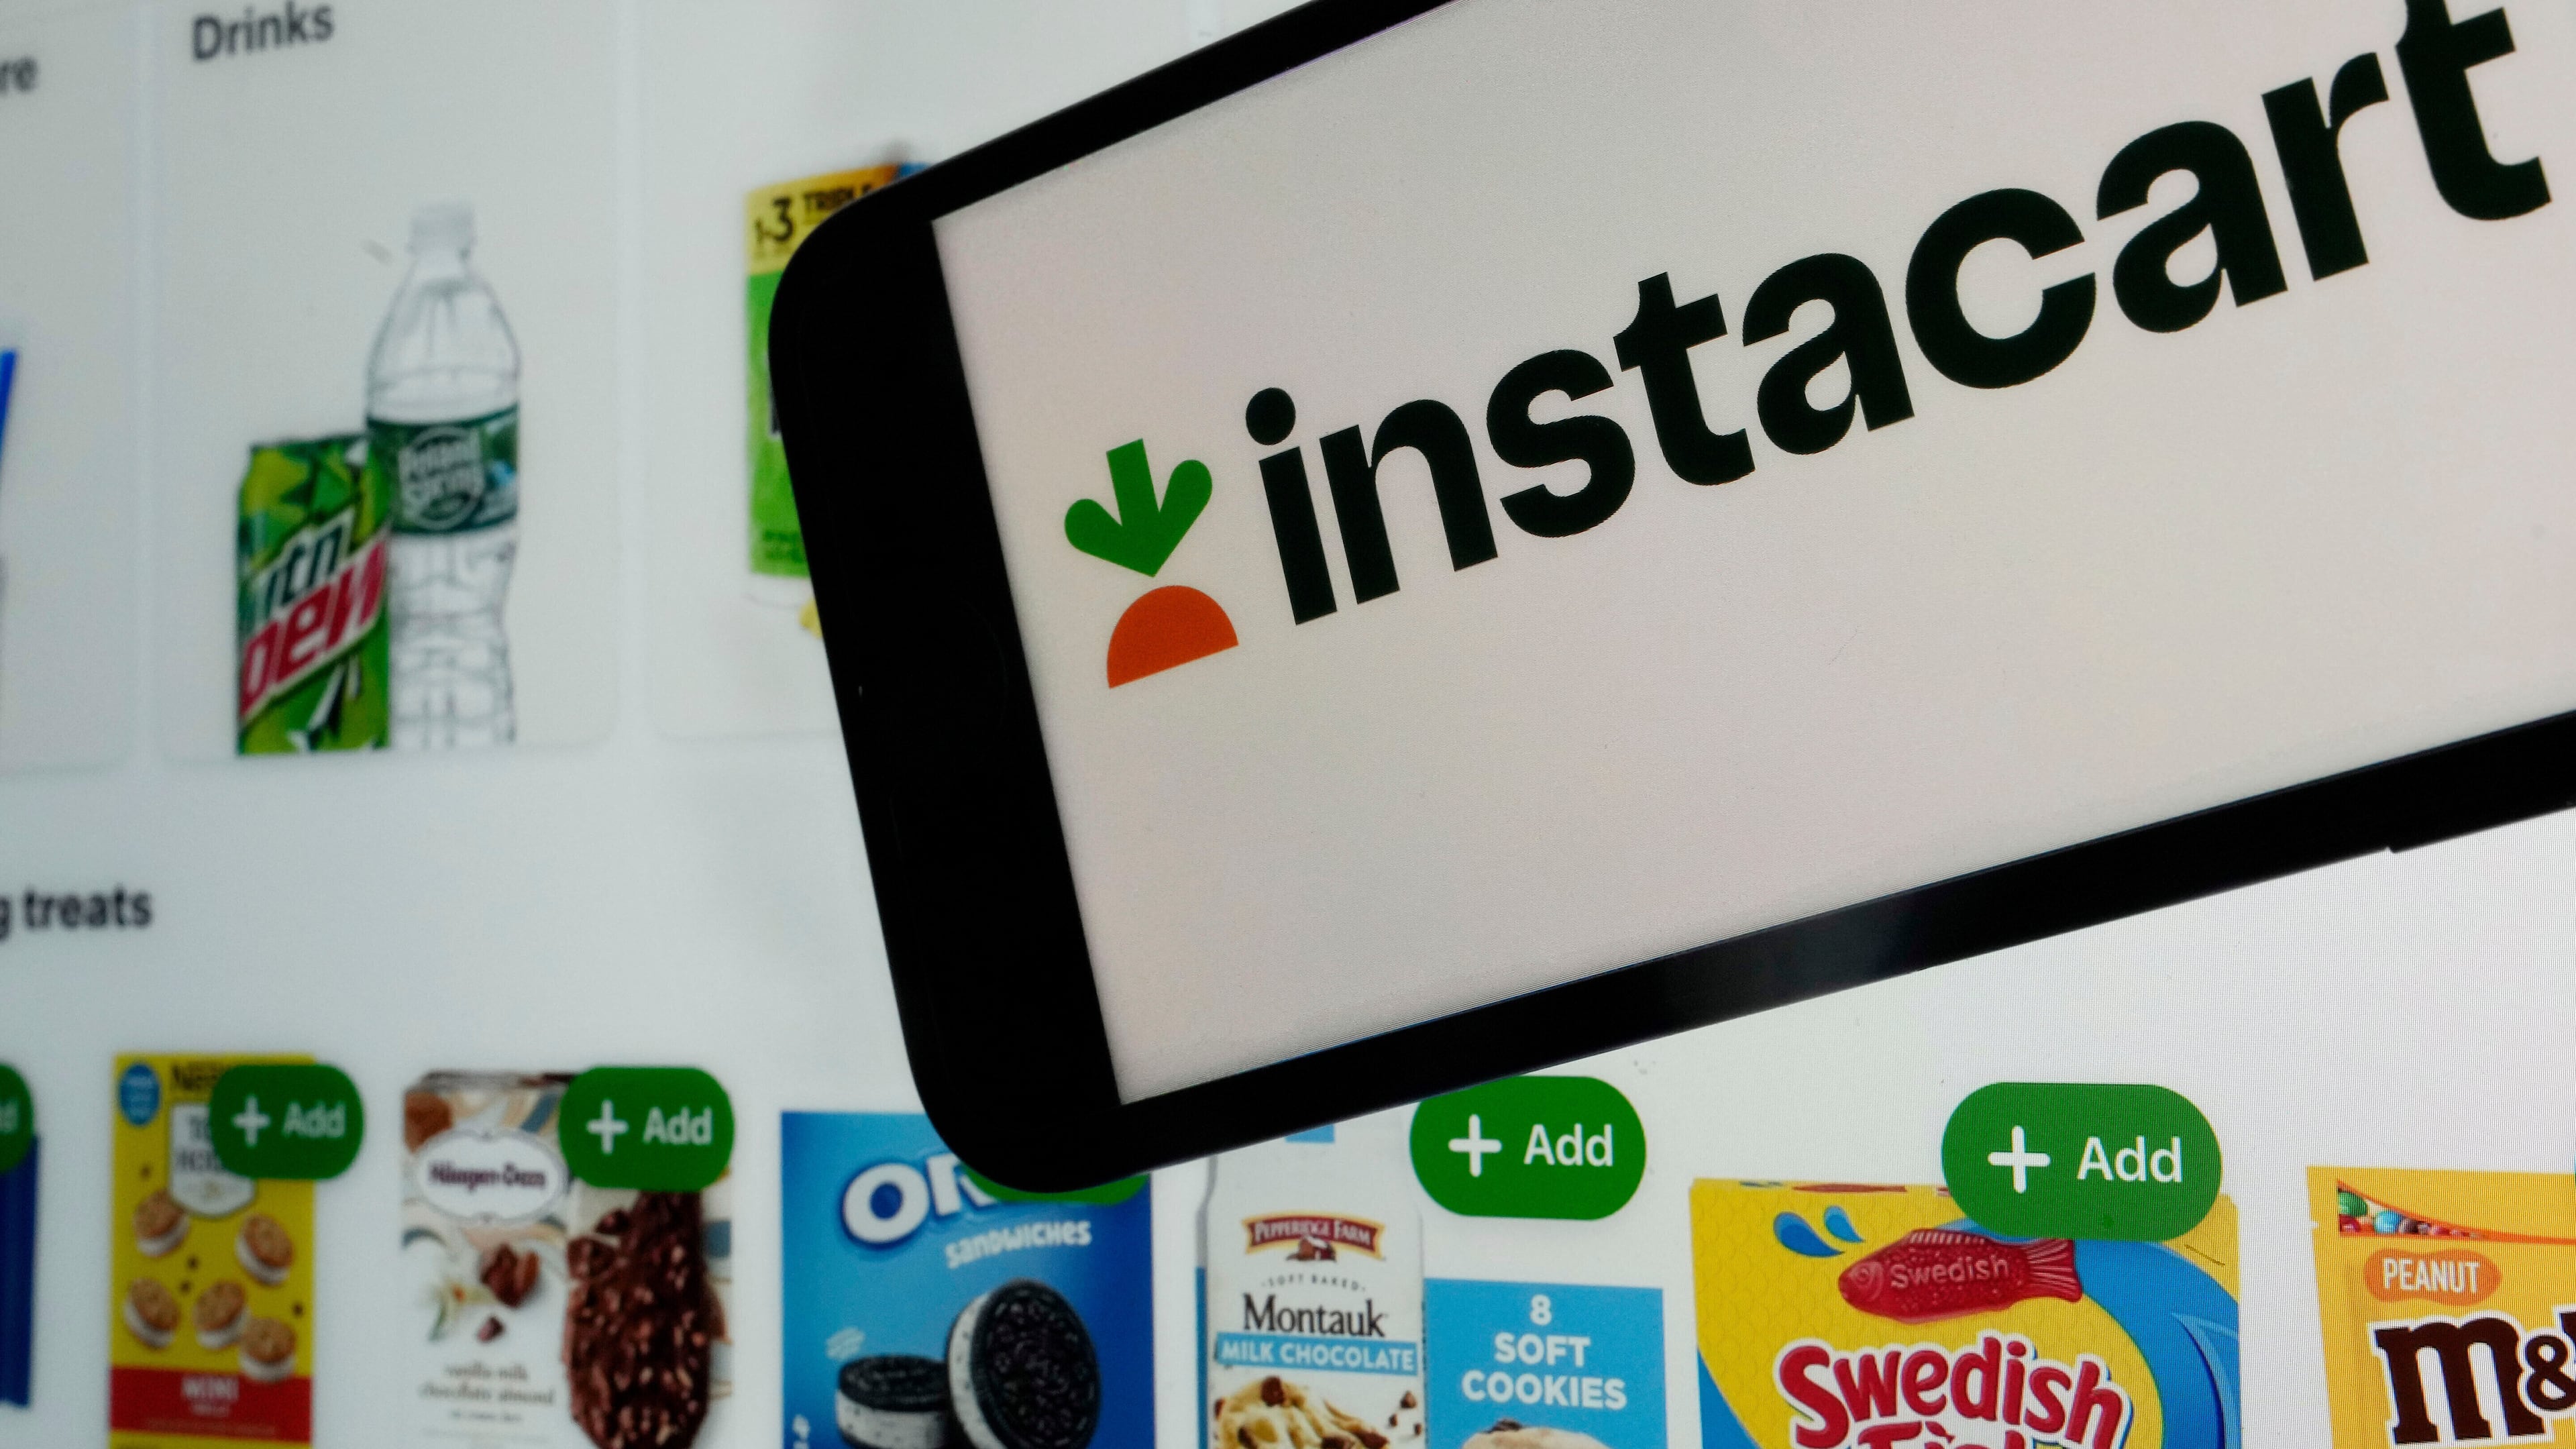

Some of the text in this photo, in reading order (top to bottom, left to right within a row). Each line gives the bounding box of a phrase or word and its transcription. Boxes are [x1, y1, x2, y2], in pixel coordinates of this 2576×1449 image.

[193, 3, 335, 62] Drinks
[1246, 0, 2553, 625] instacart
[25, 883, 152, 928] treats
[282, 1102, 346, 1139] Add
[642, 1106, 713, 1145] Add
[1523, 1124, 1614, 1167] Add
[2077, 1135, 2184, 1183] Add
[1254, 1218, 1371, 1246] PEPPERIDGE FARM
[1890, 1254, 2009, 1289] Swedish
[2383, 1258, 2481, 1295] PEANUT
[1243, 1293, 1385, 1338] Montauk
[1529, 1294, 1552, 1326] 8
[1221, 1340, 1414, 1372] MILK CHOCOLATE
[1494, 1332, 1591, 1368] SOFT
[1461, 1371, 1627, 1411] COOKIES
[1779, 1336, 2124, 1449] Swedish
[2374, 1311, 2576, 1445] m&
